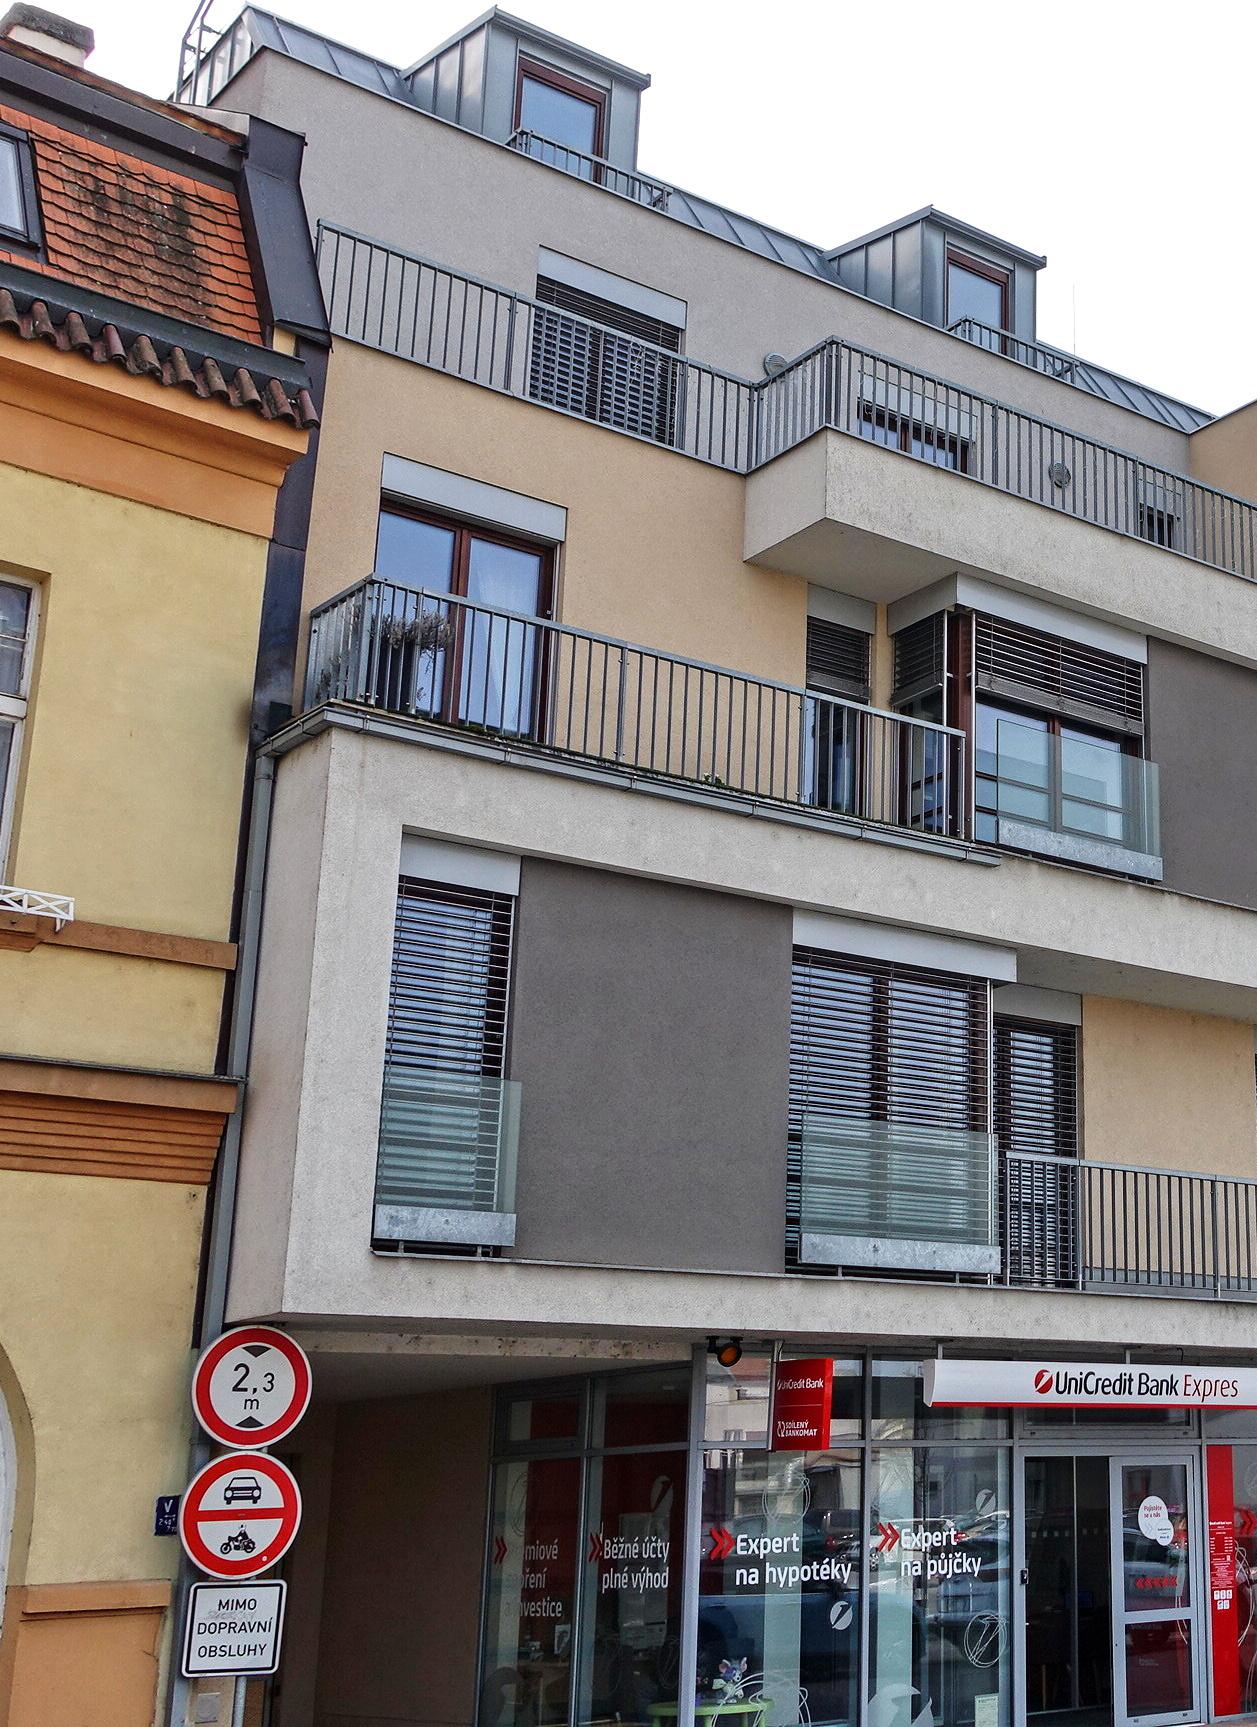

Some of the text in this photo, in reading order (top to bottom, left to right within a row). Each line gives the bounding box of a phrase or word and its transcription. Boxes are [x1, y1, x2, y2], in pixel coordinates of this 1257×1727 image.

[231, 1362, 275, 1395] 2,3
[782, 1377, 824, 1390] UniCredit Bank
[1055, 1371, 1239, 1403] UniCredit Bank Expres
[243, 1398, 260, 1410] m
[785, 1428, 818, 1437] BANKOMAT
[524, 1538, 559, 1561] miové
[603, 1535, 670, 1563] Běžné účty
[736, 1533, 800, 1558] Expert
[901, 1526, 958, 1552] Expert
[735, 1558, 852, 1588] na hypotéky
[901, 1552, 982, 1579] na půjčky
[520, 1567, 548, 1589] oření
[602, 1566, 670, 1594] plné výhod
[217, 1598, 257, 1612] MIMO
[519, 1596, 562, 1617] nvestice
[197, 1617, 273, 1635] DOPRAVNÍ
[197, 1643, 268, 1659] OBSLUHY
